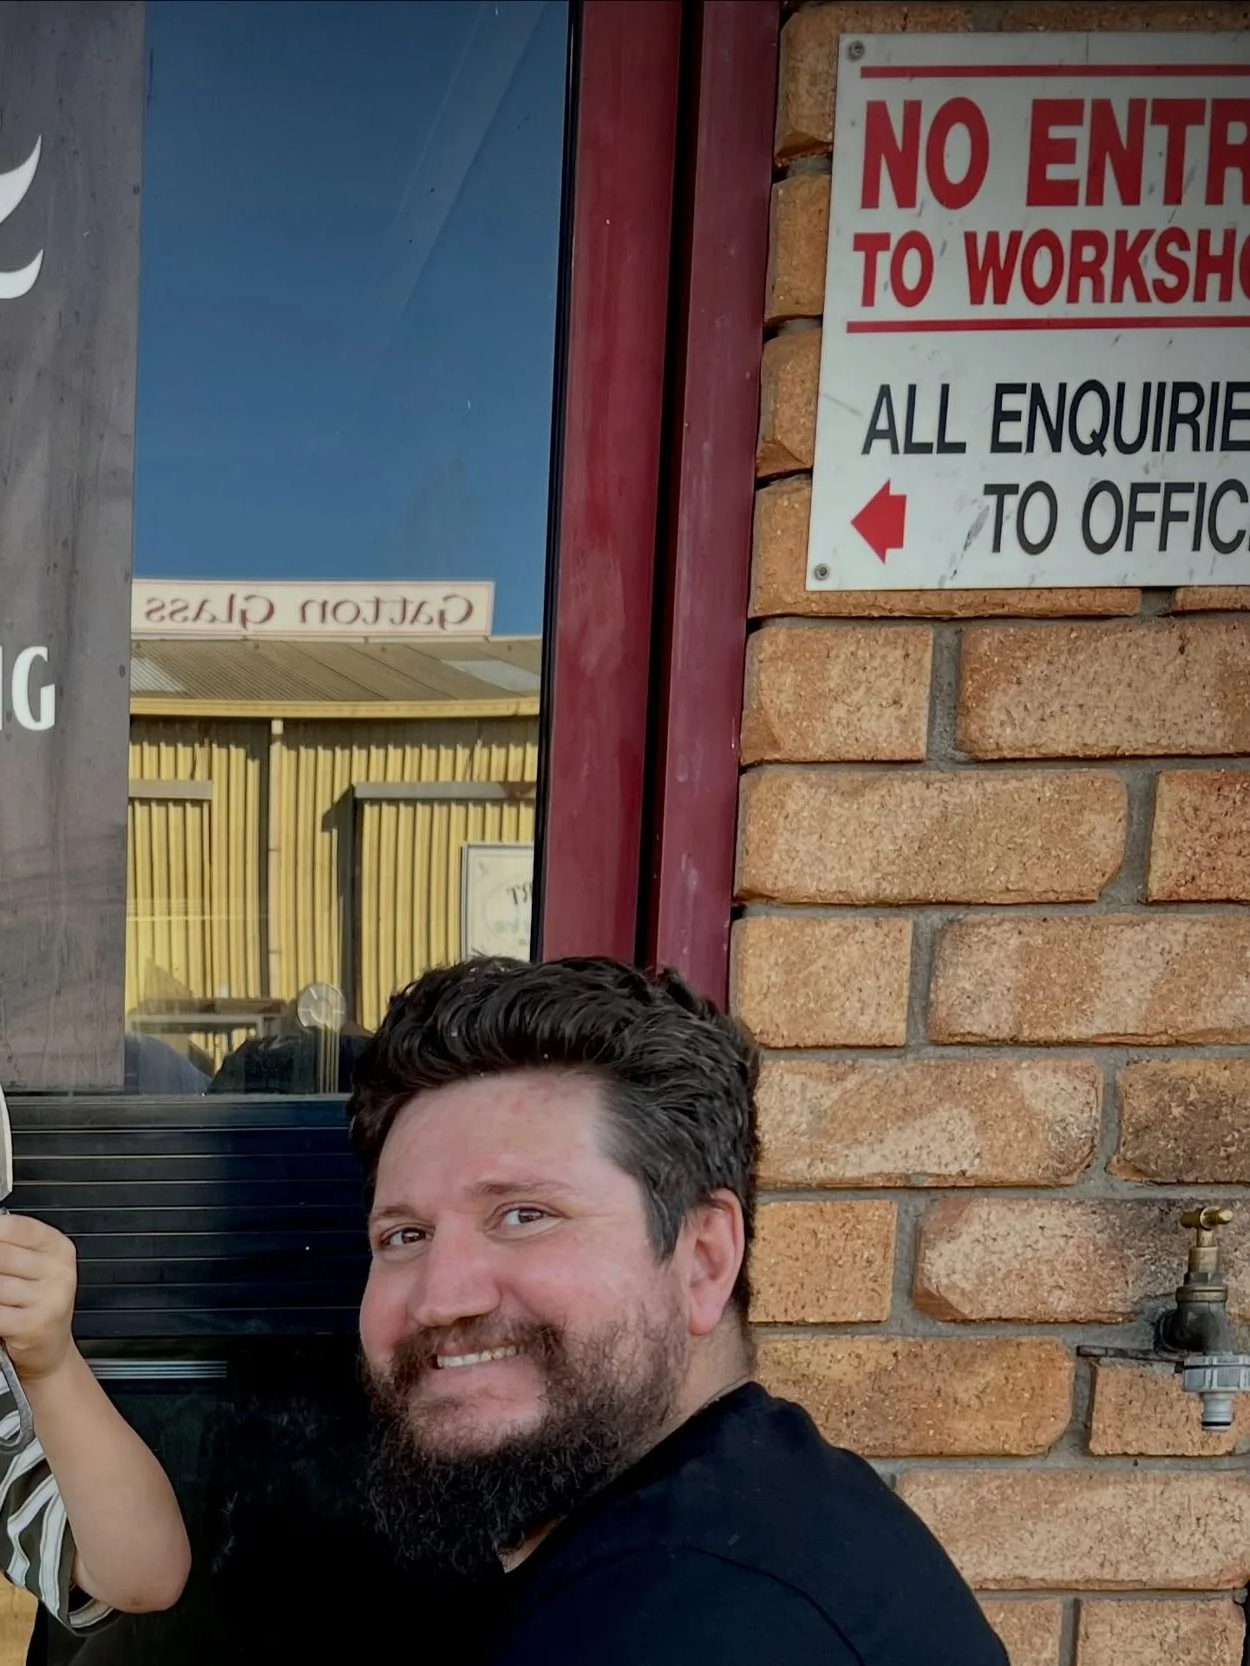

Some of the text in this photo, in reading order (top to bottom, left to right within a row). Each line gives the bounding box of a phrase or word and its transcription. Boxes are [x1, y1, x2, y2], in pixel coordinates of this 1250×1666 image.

[861, 97, 1250, 210] NO ENTR
[853, 227, 1250, 308] TO WORKSH
[861, 378, 1250, 457] ALL ENQUIRIE
[983, 478, 1250, 556] TO OFFIC
